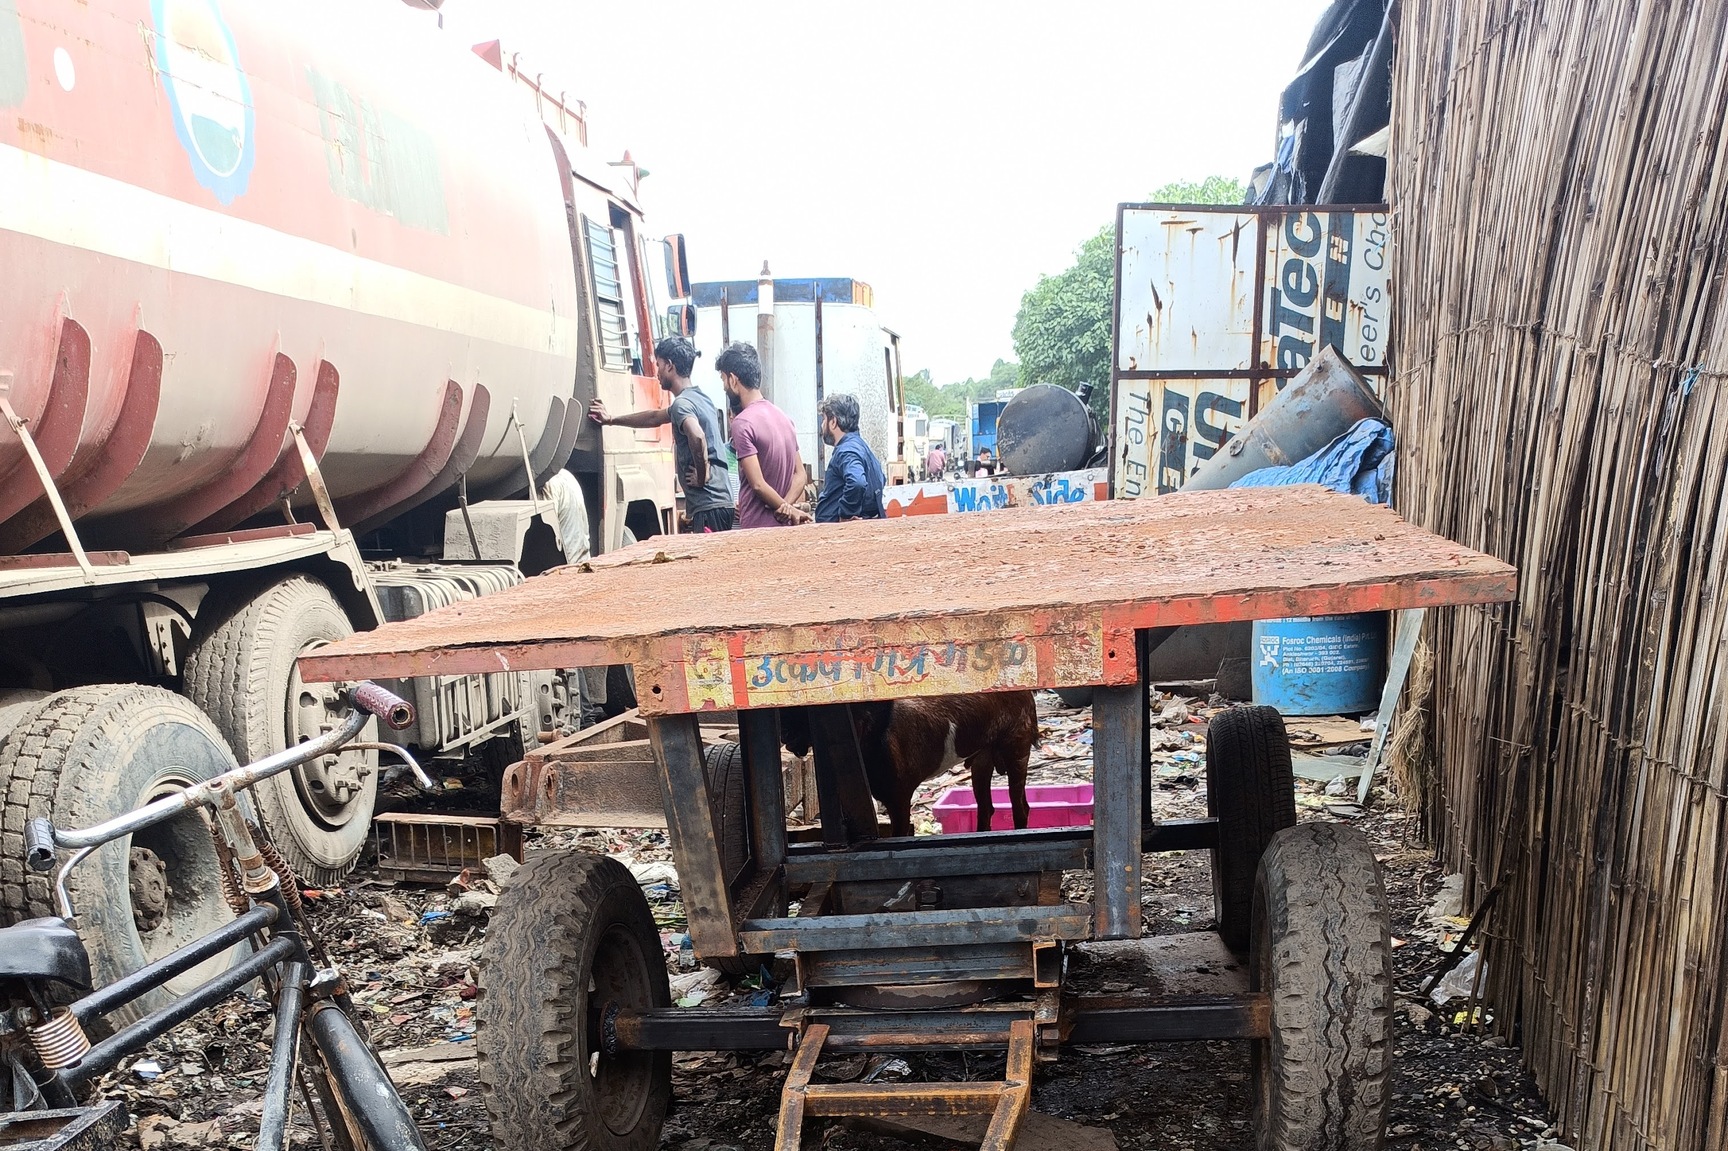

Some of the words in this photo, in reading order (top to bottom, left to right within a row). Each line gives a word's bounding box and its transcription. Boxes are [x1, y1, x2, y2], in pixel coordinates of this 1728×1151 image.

[1359, 286, 1382, 382] eer's
[1129, 391, 1151, 446] The
[1031, 479, 1086, 505] Side
[1282, 636, 1305, 645] Fosroc
[1306, 634, 1341, 644] Chemicals
[1342, 633, 1361, 644] (India)
